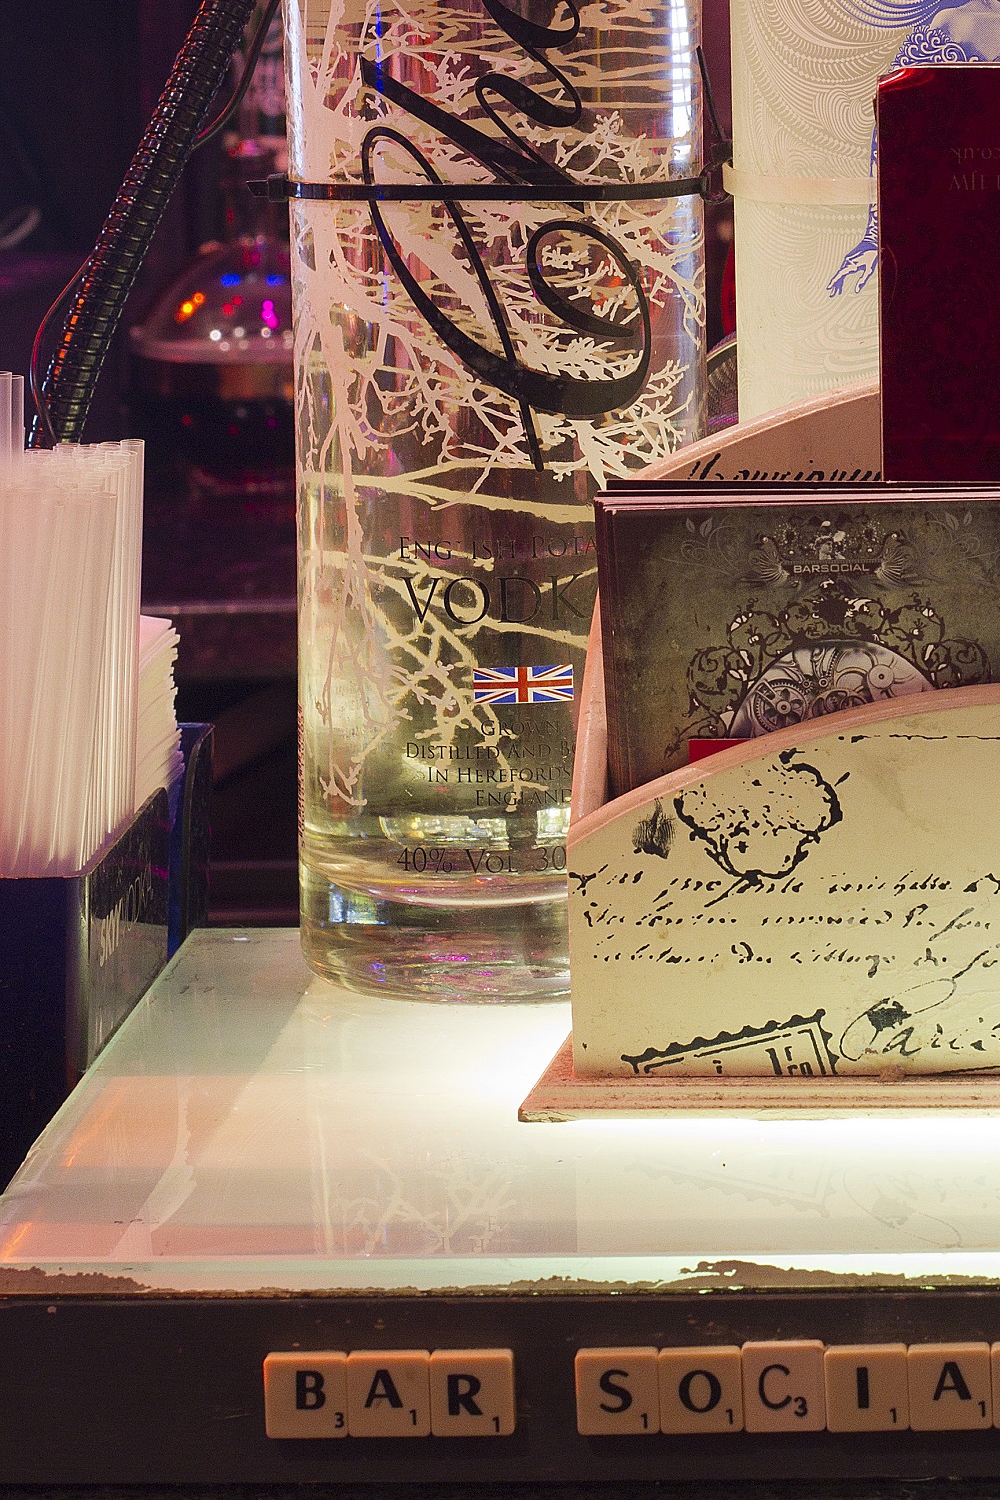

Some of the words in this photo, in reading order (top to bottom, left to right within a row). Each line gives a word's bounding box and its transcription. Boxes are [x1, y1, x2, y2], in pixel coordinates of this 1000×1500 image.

[793, 563, 870, 575] BARSOCIAL
[401, 575, 593, 624] VODK
[294, 1368, 482, 1417] BAR
